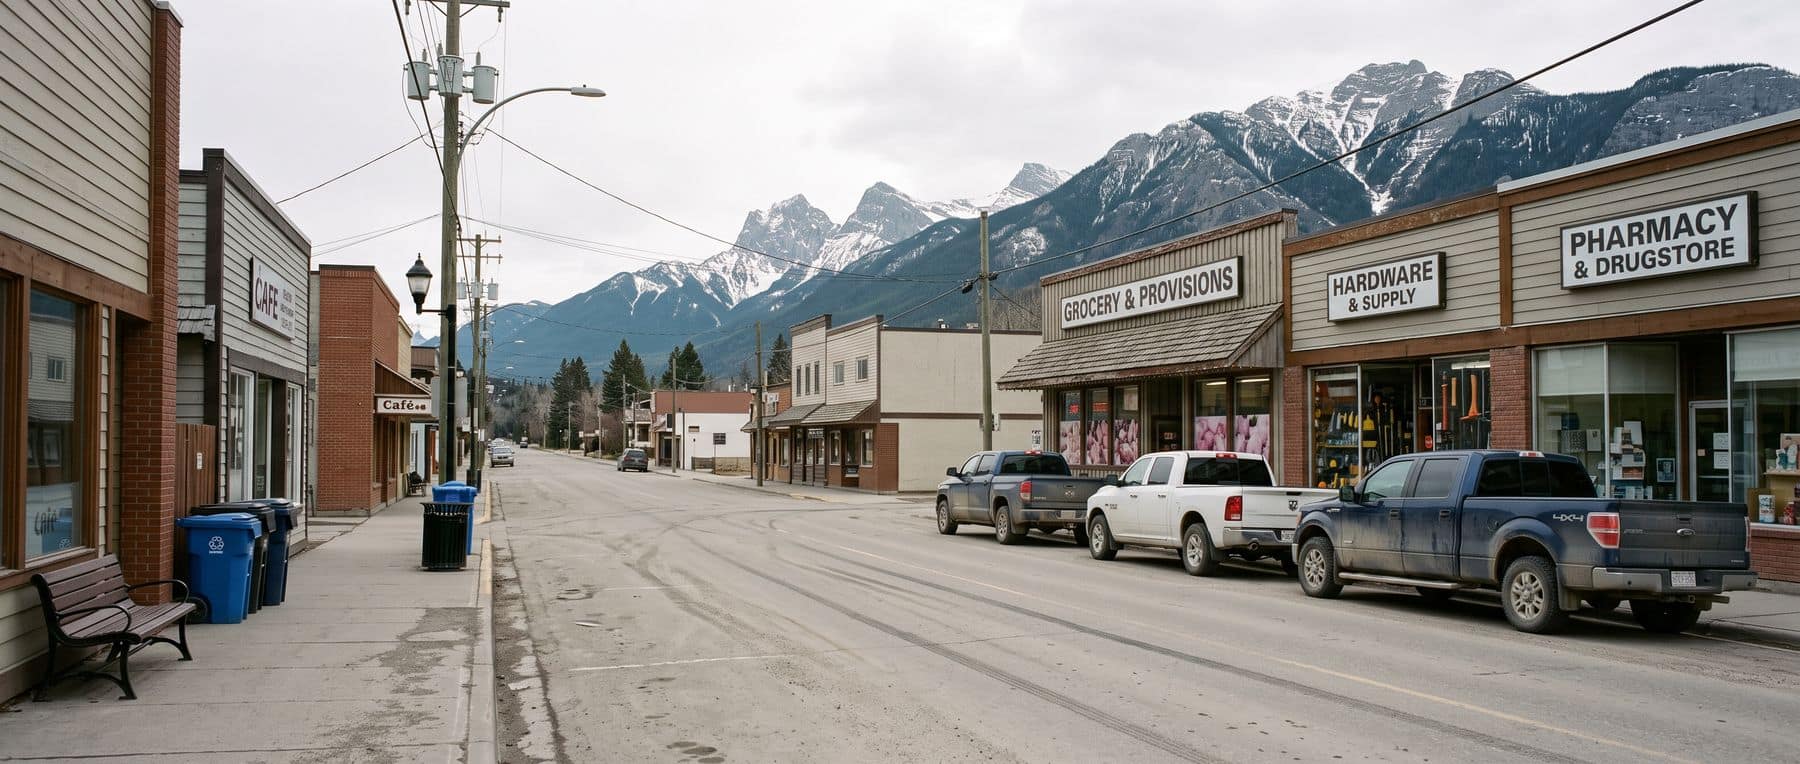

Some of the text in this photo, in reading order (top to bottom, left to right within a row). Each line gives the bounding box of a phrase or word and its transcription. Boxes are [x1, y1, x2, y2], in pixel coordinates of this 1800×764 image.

[1570, 203, 1738, 257] PHARMACY
[1333, 260, 1433, 297] HARDWARE
[1574, 236, 1735, 280] & DRUGSTORE
[255, 276, 279, 321] CAFE
[1064, 265, 1234, 322] GROCERY & PROVISIONS
[1348, 287, 1417, 313] & SUPPLY
[383, 399, 414, 410] Café
